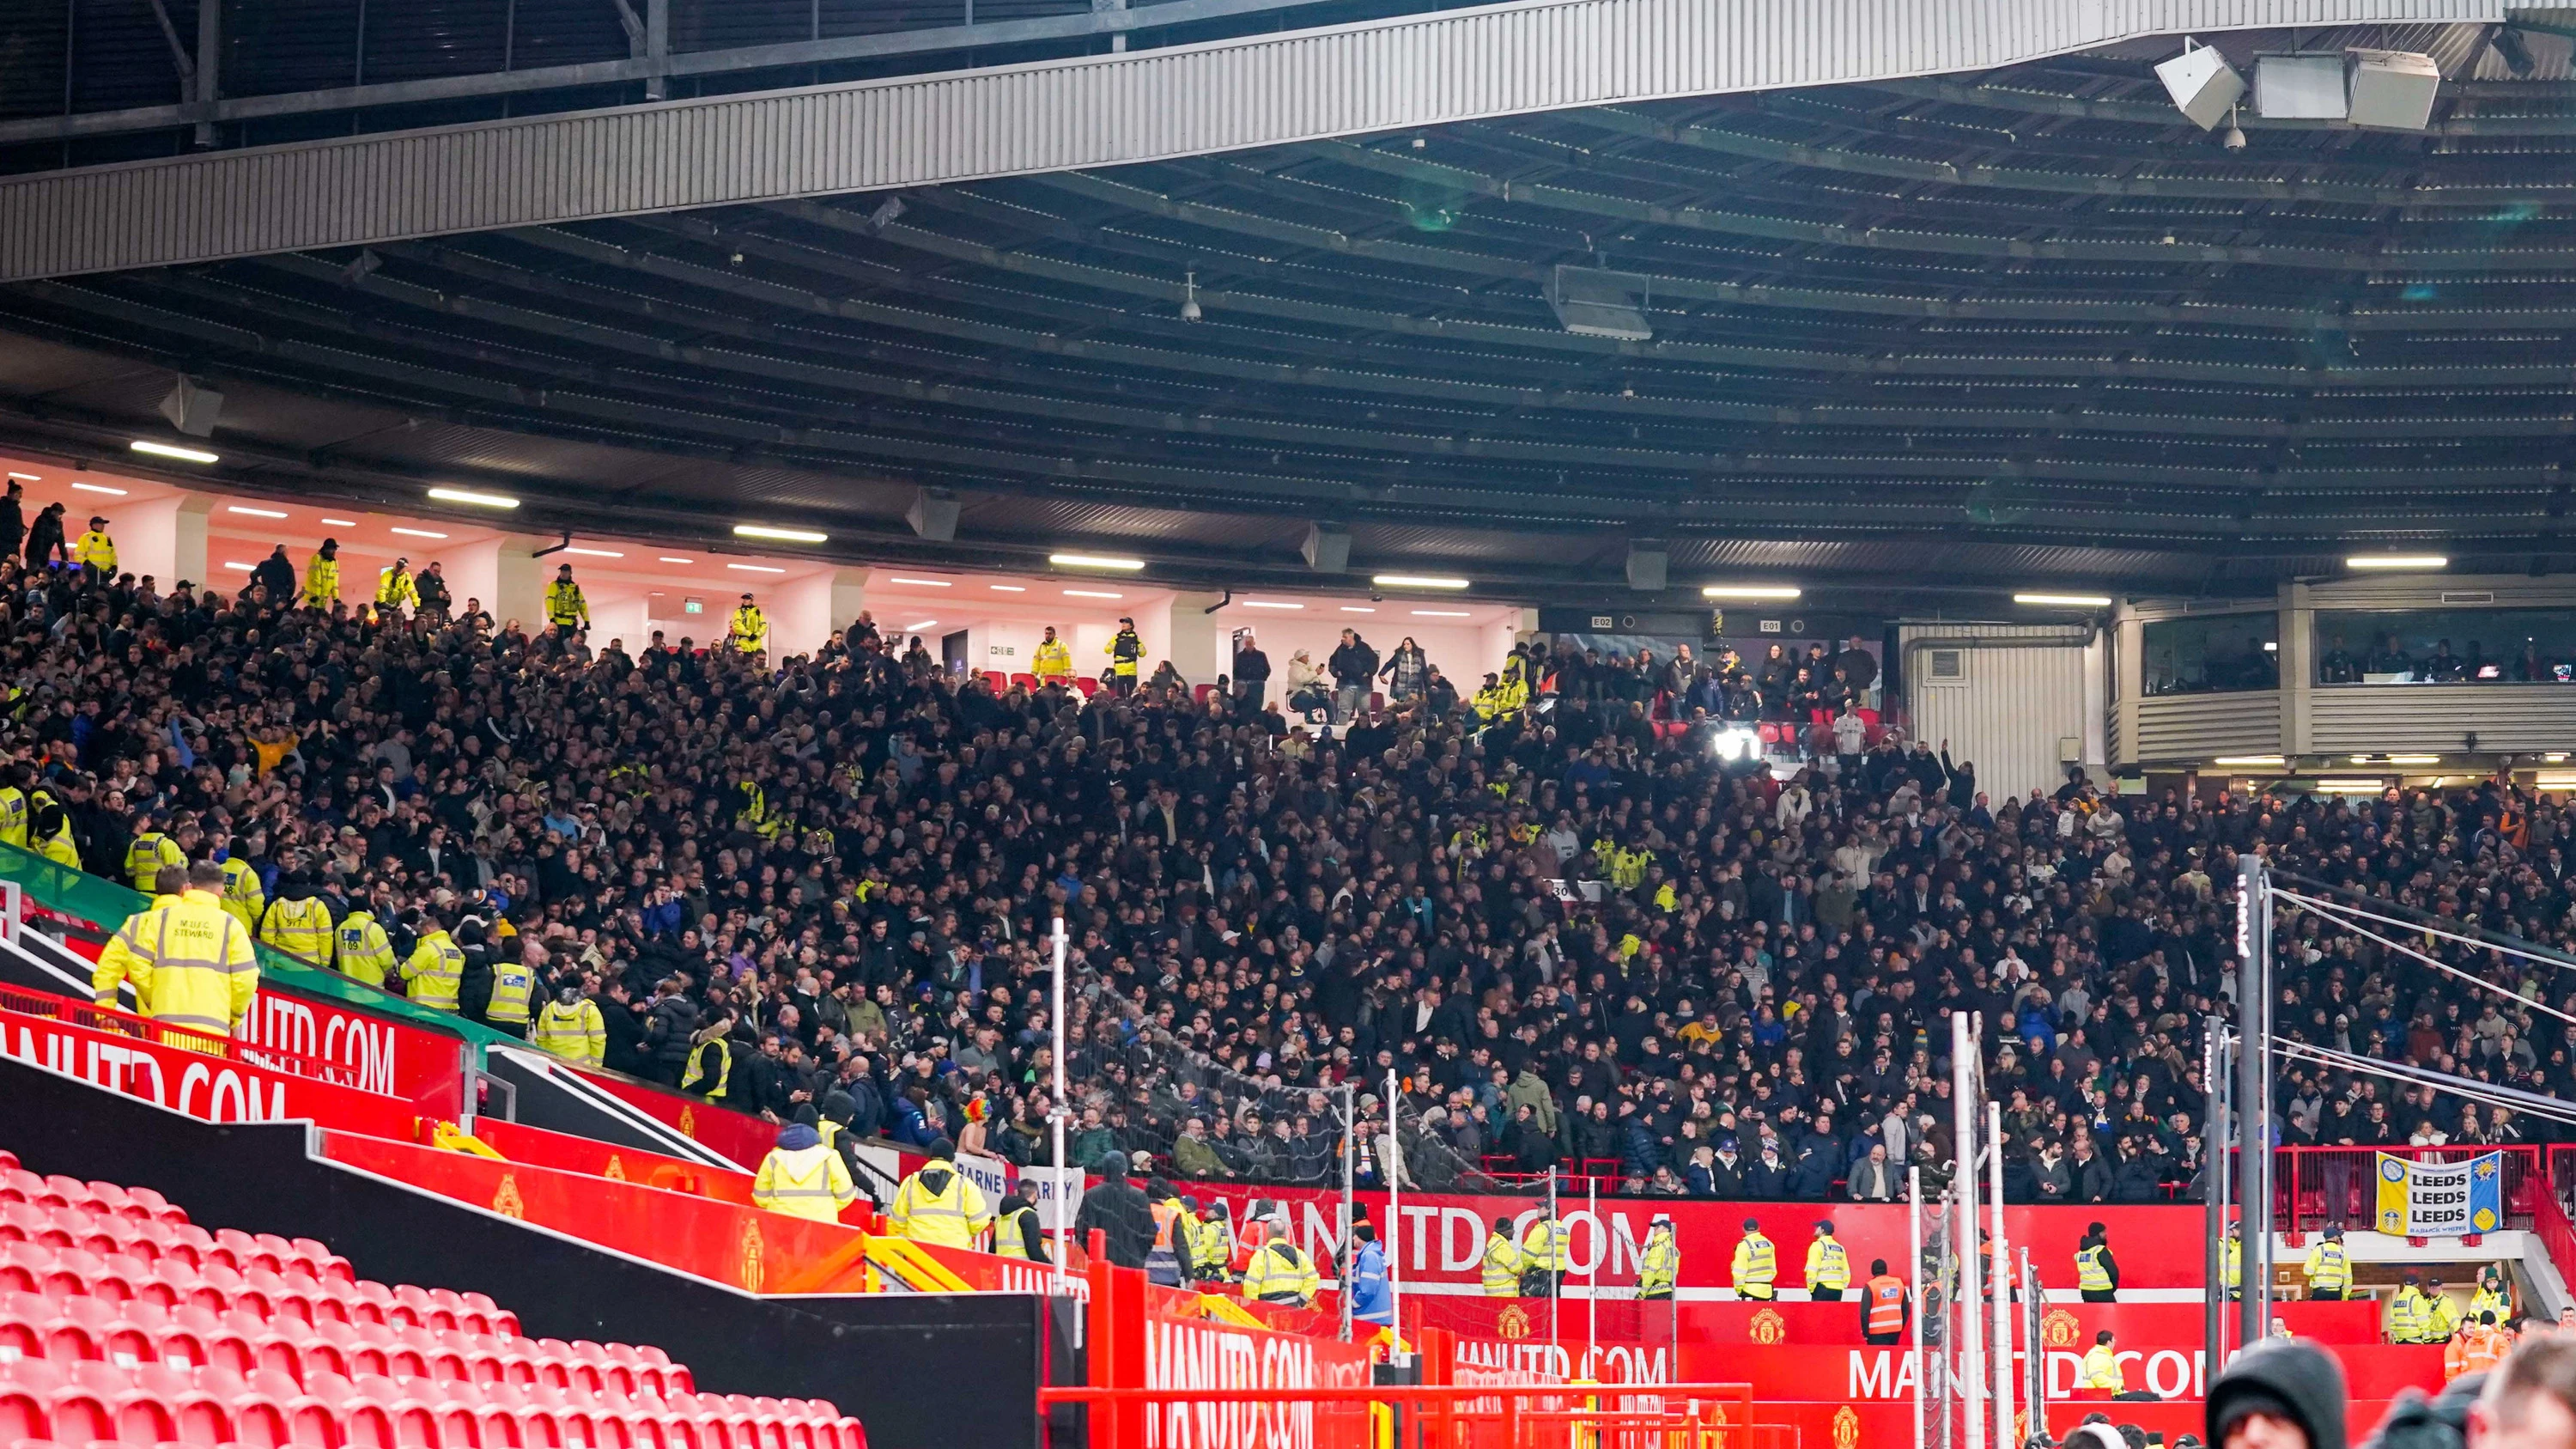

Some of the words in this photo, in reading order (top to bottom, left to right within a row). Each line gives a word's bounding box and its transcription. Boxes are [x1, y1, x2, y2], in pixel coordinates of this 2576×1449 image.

[1594, 618, 1611, 626] E02
[174, 928, 214, 940] STEWARD
[2412, 1173, 2467, 1187] LEEDS
[2412, 1191, 2466, 1204] LEEDS
[2412, 1209, 2466, 1223] LEEDS
